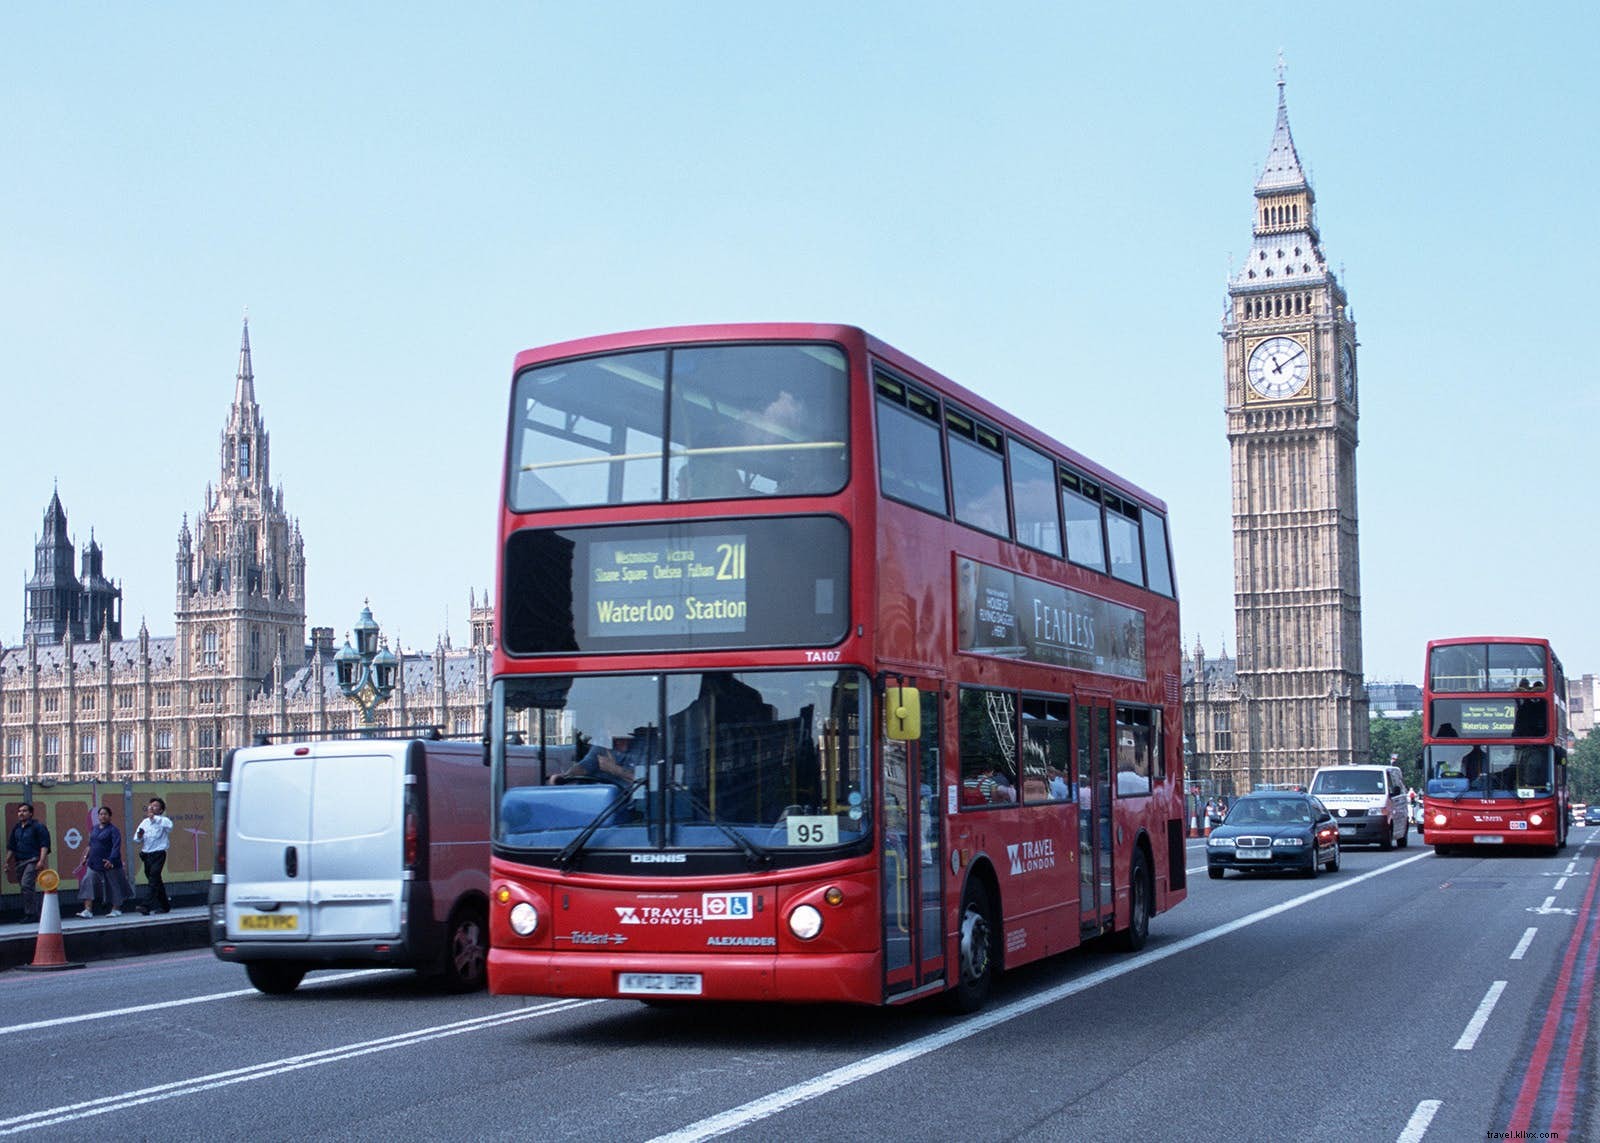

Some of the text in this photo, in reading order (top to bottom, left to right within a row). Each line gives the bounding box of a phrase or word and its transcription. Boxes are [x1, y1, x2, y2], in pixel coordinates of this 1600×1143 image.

[716, 543, 746, 580] 211
[597, 596, 747, 624] Waterloo Station
[1033, 599, 1095, 649] FEARLESS
[805, 651, 840, 662] TA107
[797, 824, 824, 843] 95
[1022, 839, 1055, 859] TRAVEL
[631, 854, 686, 863] DENNIS
[1022, 856, 1055, 873] LONDON
[641, 907, 703, 918] TRAVEL
[570, 931, 609, 945] Trident
[707, 936, 776, 946] ALEXANDER
